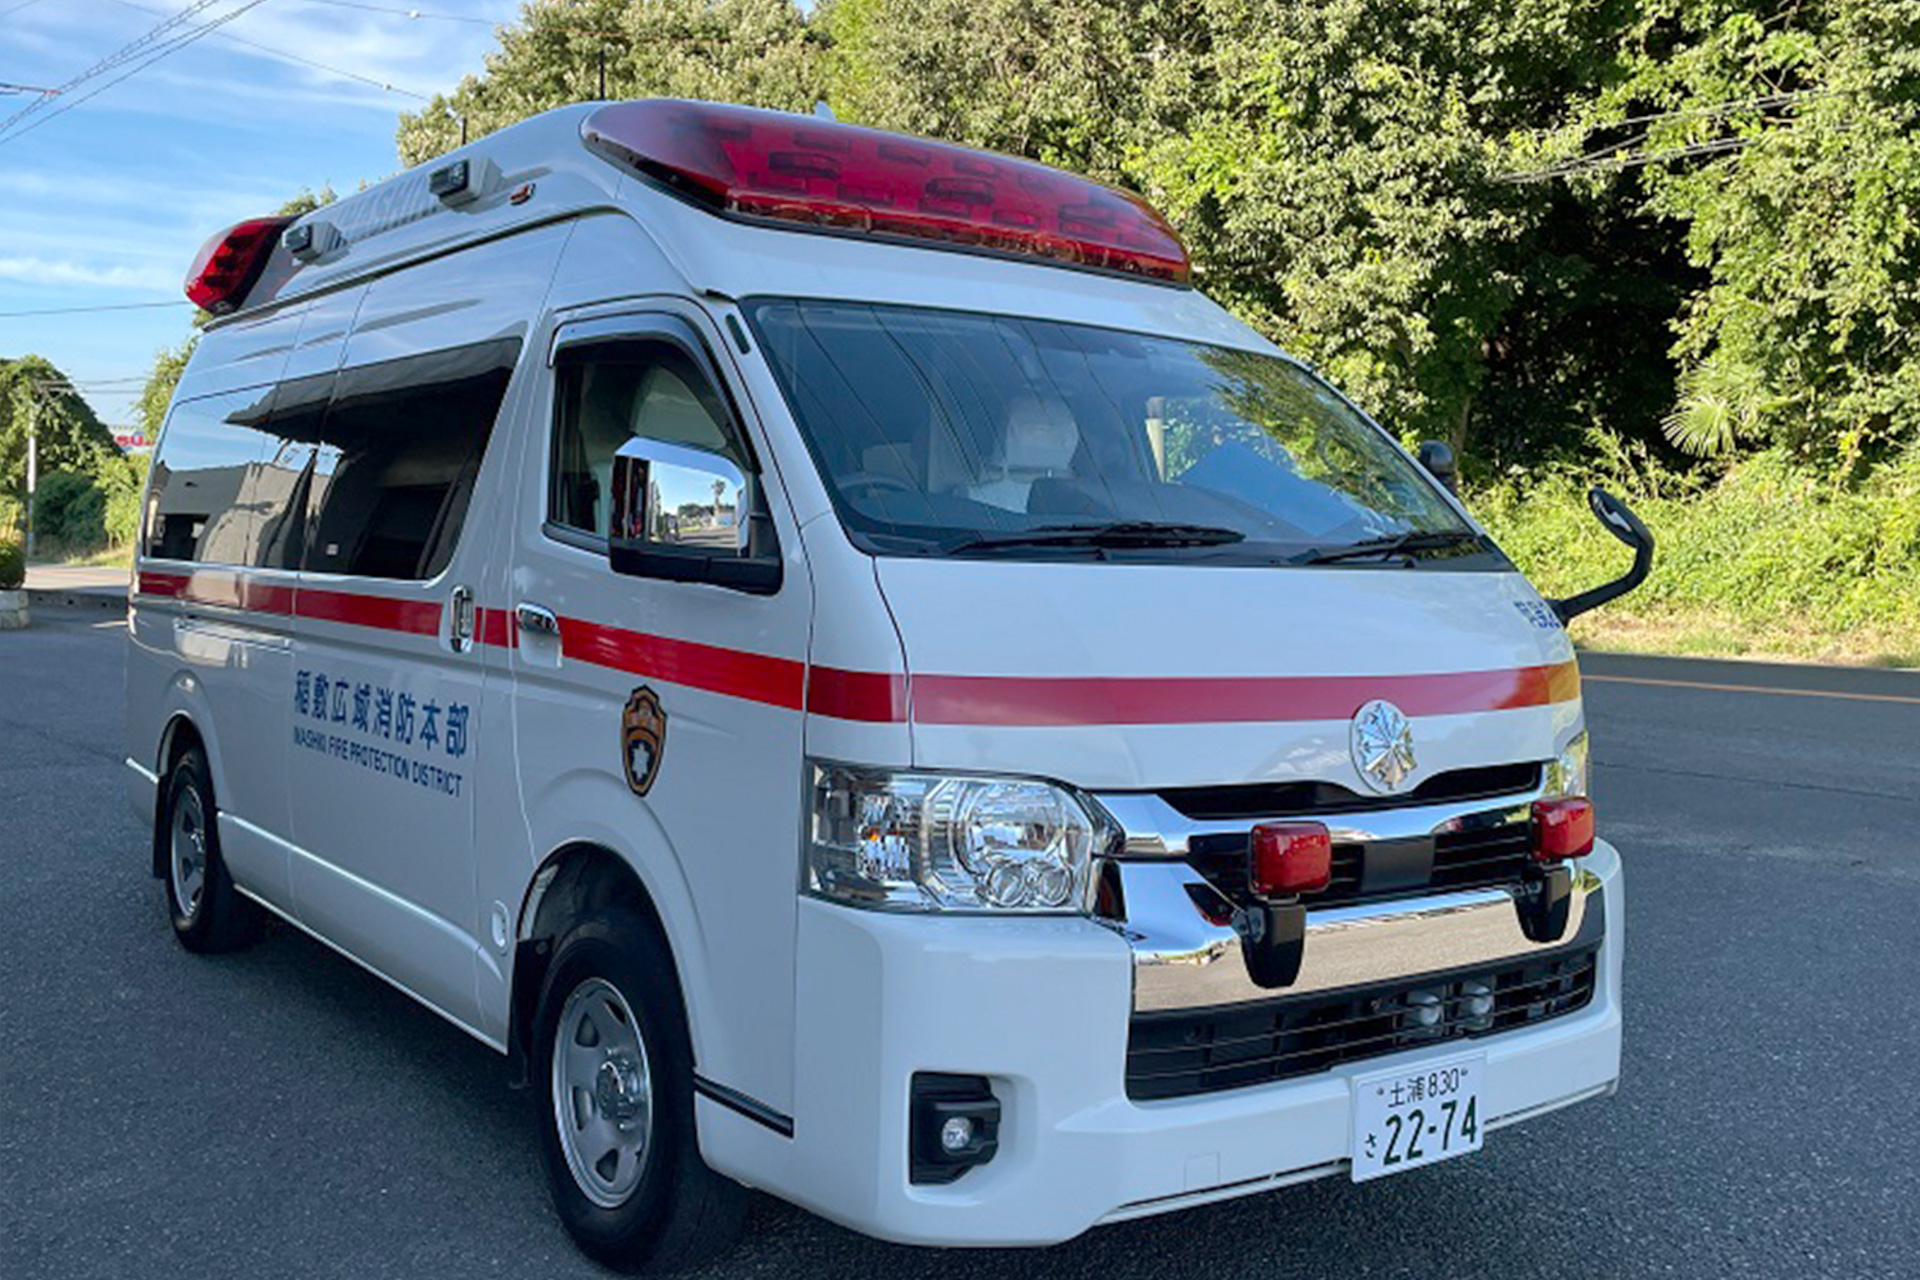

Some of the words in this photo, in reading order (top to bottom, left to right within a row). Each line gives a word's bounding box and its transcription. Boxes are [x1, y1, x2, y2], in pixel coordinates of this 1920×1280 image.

[295, 670, 469, 758] 稲敷広域消防本部
[328, 736, 348, 761] FIRE
[350, 742, 409, 780] PROTECTION
[413, 761, 462, 797] DISTRICT
[1428, 1068, 1459, 1098] 830
[1365, 1133, 1377, 1158] さ
